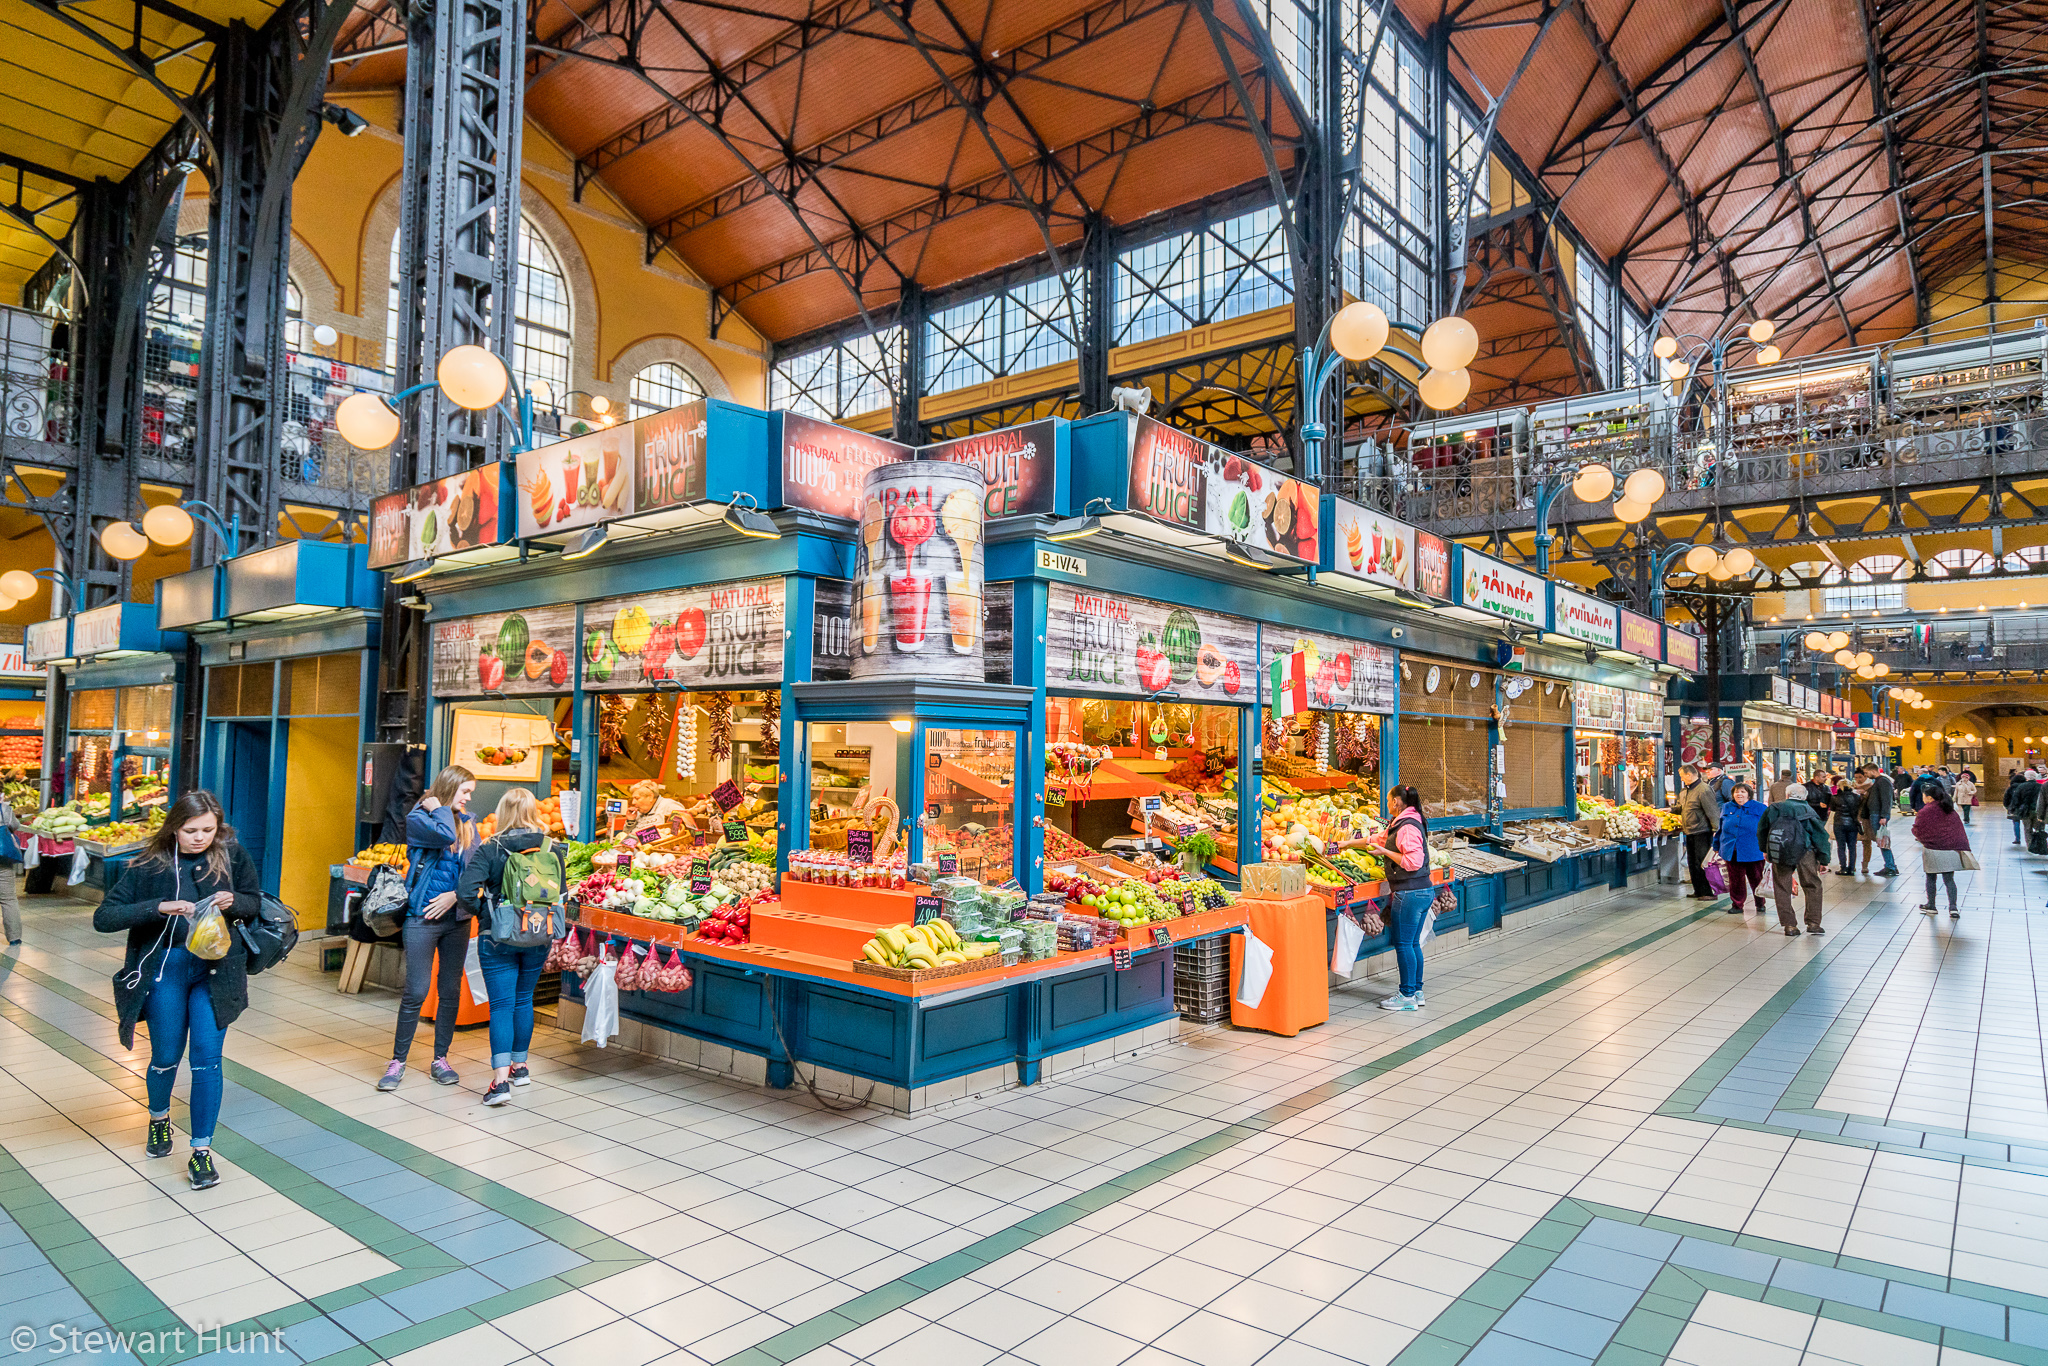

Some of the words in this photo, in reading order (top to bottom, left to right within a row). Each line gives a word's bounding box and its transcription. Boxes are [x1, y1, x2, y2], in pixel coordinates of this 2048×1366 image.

[644, 406, 700, 440] NATURAL
[644, 429, 700, 473] FRUIT
[795, 441, 840, 464] NATURAL
[954, 430, 1026, 461] NATURAL
[1156, 426, 1205, 462] NATURAL
[789, 445, 836, 492] 100%
[1152, 448, 1203, 493] FRUIT
[640, 465, 695, 507] JUICE
[1145, 482, 1198, 525] JUICE
[1419, 547, 1443, 574] FRUIT
[1417, 570, 1442, 596] JUICE
[710, 586, 773, 610] NATURAL
[1075, 594, 1131, 621] NATURAL
[440, 623, 475, 640] NATURAL
[709, 608, 770, 643] FRUIT
[1072, 617, 1128, 651] FRUIT
[439, 639, 474, 664] FRUIT
[704, 642, 765, 678] JUICE
[1353, 644, 1382, 661] NATURAL
[436, 664, 470, 690] JUICE
[1067, 650, 1125, 685] JUICE
[1353, 659, 1382, 683] FRUIT
[1351, 682, 1380, 707] JUICE
[930, 730, 950, 747] 100%
[974, 737, 991, 748] fruit
[992, 740, 1010, 751] juice
